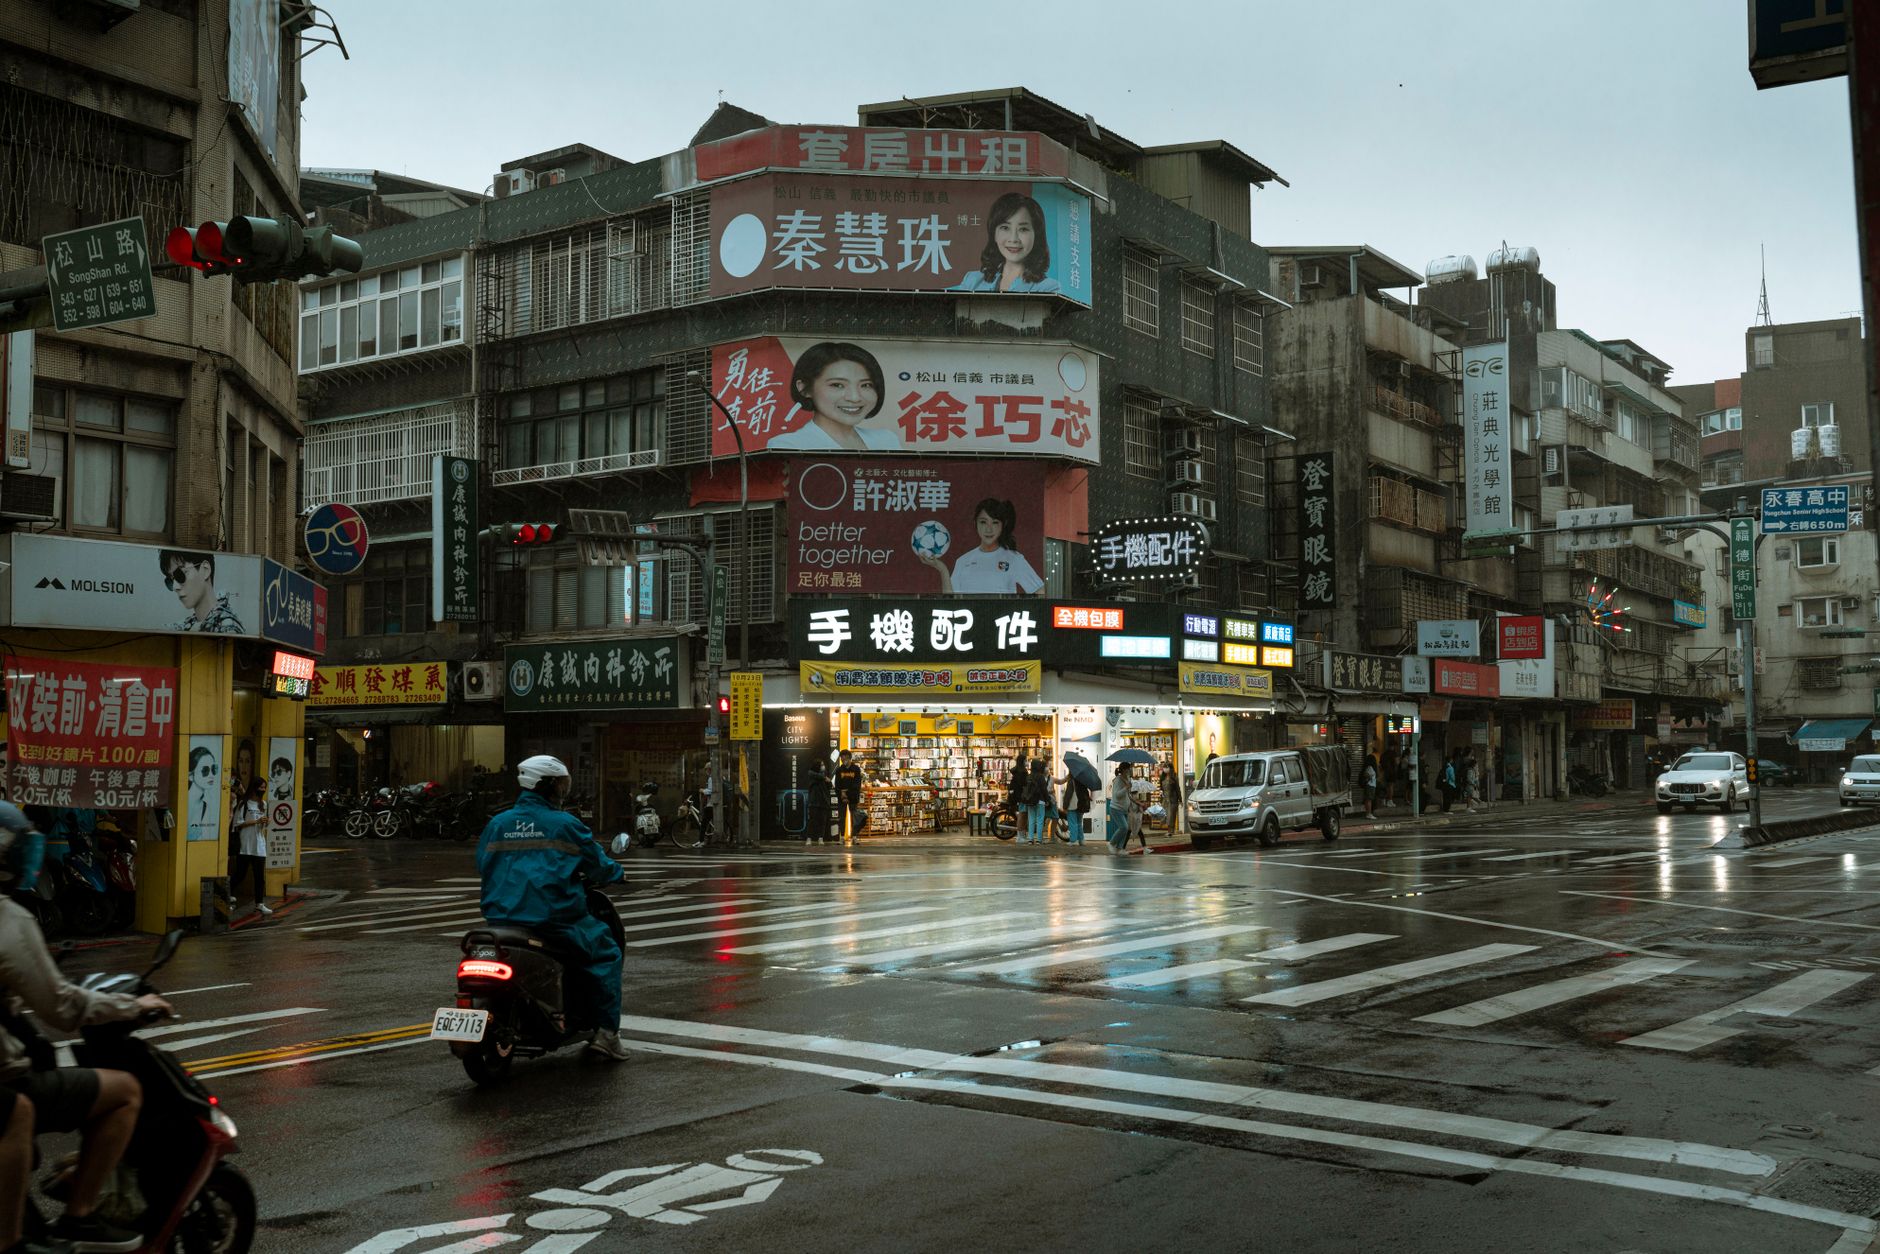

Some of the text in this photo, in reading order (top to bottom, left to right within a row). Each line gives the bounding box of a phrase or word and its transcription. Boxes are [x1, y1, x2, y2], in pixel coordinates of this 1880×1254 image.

[799, 129, 1027, 174] 套房出租
[774, 185, 800, 199] 松山
[957, 213, 981, 227] 博士
[55, 228, 135, 269] 松山路
[773, 209, 952, 275] 秦慧珠
[115, 262, 130, 276] Rd.
[916, 371, 1034, 386] 松山 信義 市議員
[897, 390, 1092, 448] 徐巧芯
[1482, 391, 1501, 515] 莊典光學館
[853, 480, 951, 512] 許淑華
[1765, 489, 1845, 507] 永春高中
[798, 521, 867, 542] better
[1302, 459, 1333, 603] 登寶眼鏡
[452, 484, 470, 605] 康誠內科診所
[1100, 529, 1196, 569] 手機配件
[1735, 529, 1750, 582] 福德街
[798, 545, 894, 569] together
[71, 579, 134, 595] MOLSION
[798, 571, 862, 588] 足你最強
[1058, 609, 1120, 628] 全機包膜
[1186, 616, 1216, 634] 行動電源
[808, 608, 1038, 655] 手機配件
[1504, 636, 1537, 648] 店到店
[537, 647, 673, 688] 康誠內科診所
[834, 669, 953, 687] 消費滿額贈送包膜
[1333, 655, 1384, 689] 登寶眼鏡
[311, 665, 445, 695] 金順發煤氣
[781, 736, 809, 744] LIGHTS
[787, 726, 804, 734] CITY
[13, 764, 160, 788] 午後咖啡 午後拿鐵
[13, 785, 158, 807] 20元/杯 30元/杯
